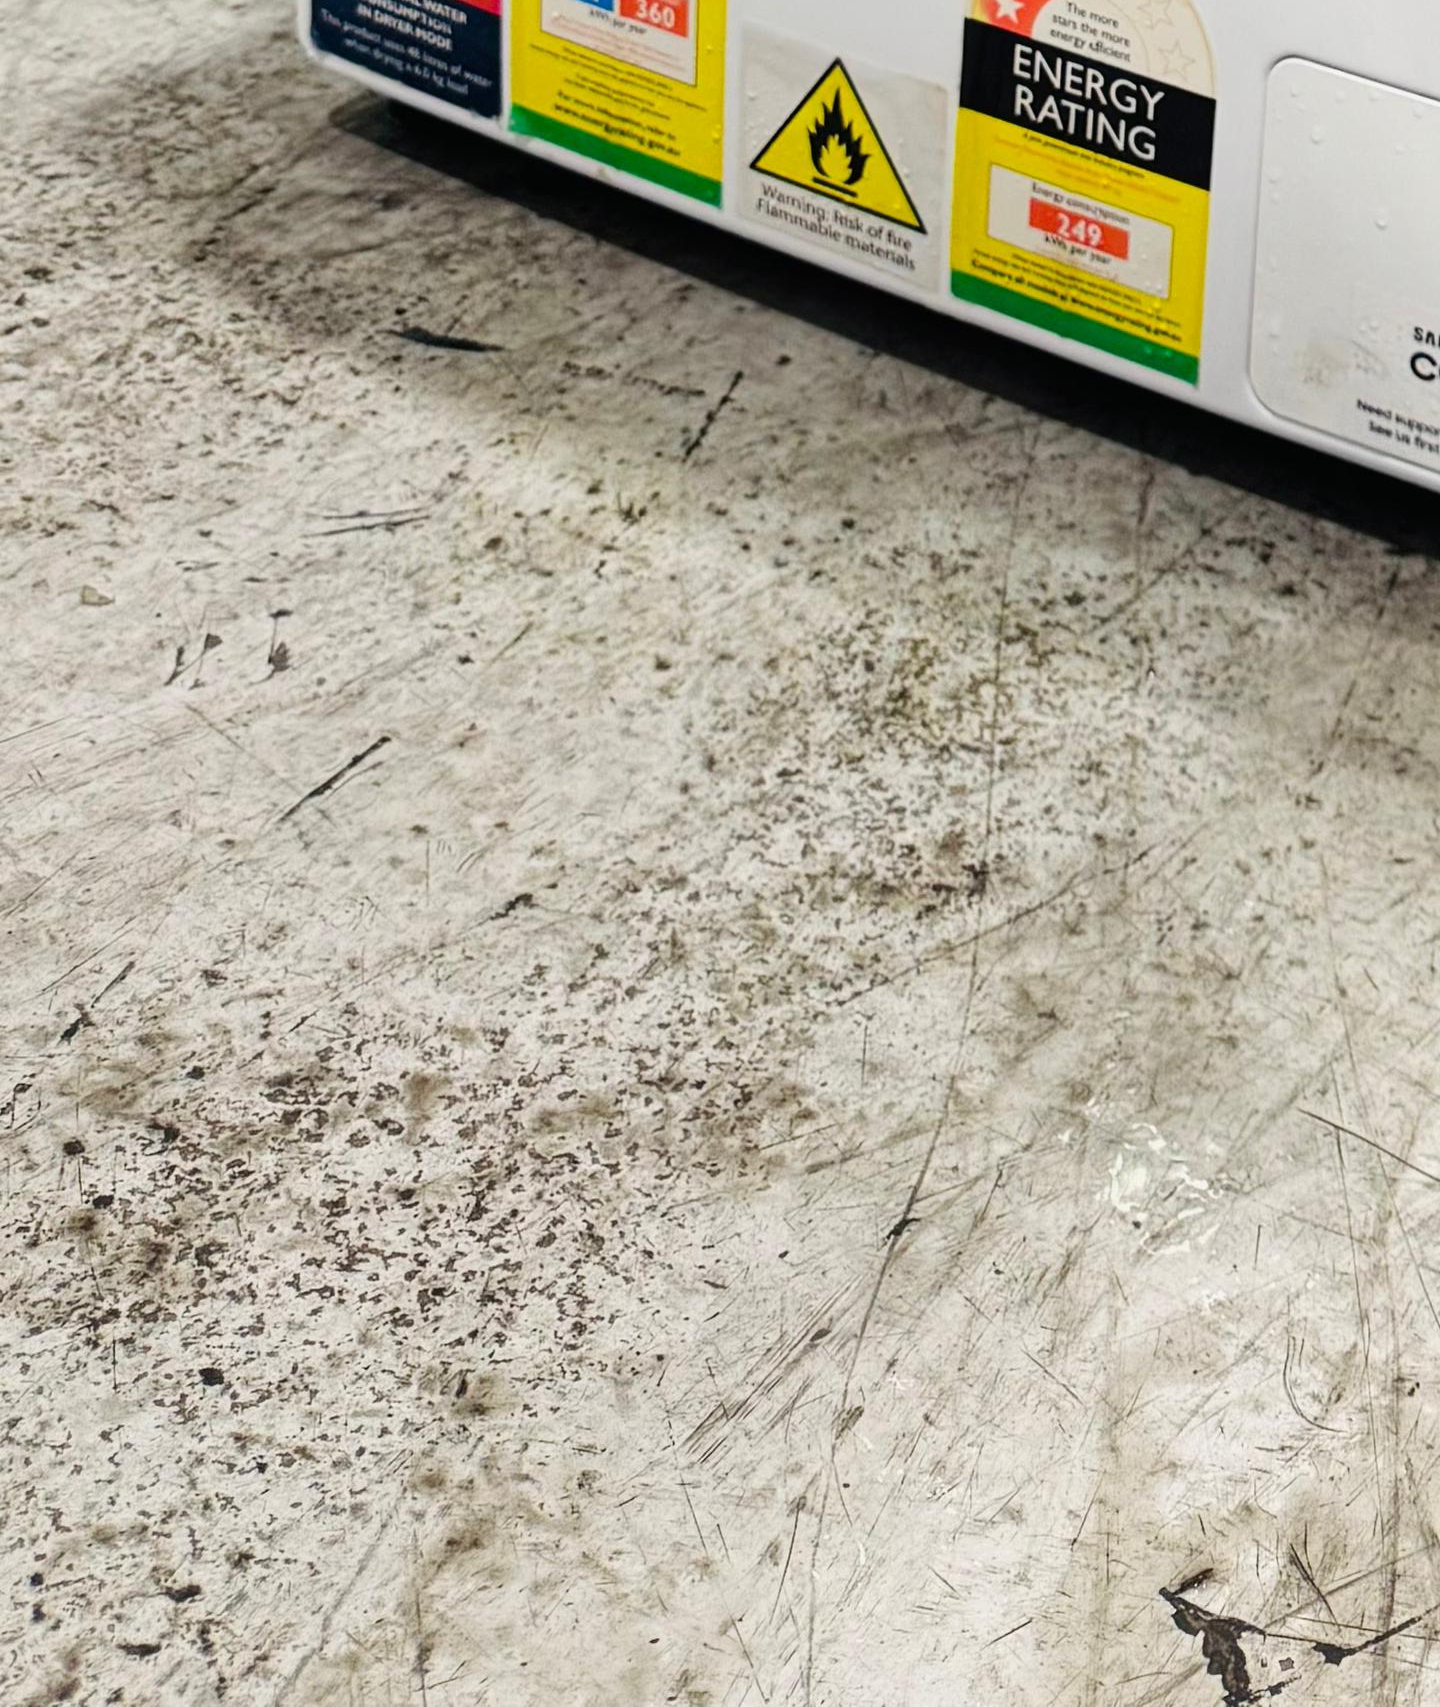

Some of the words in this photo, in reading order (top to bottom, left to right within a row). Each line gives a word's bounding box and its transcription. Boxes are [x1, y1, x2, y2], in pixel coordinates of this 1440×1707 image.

[373, 9, 414, 36] DRYER
[415, 27, 453, 52] MODE
[1051, 13, 1078, 33] stars
[1080, 20, 1099, 37] the
[1101, 30, 1132, 48] more
[1065, 0, 1088, 20] The
[1089, 10, 1120, 29] more
[1049, 28, 1087, 51] energy
[1088, 37, 1132, 63] efficient
[1012, 43, 1166, 122] ENERGY
[1014, 83, 1157, 162] RATING
[1032, 180, 1065, 205] Energy
[756, 197, 843, 243] Flammable
[846, 234, 917, 272] materials
[761, 183, 830, 223] Warning:
[834, 210, 865, 235] Risk
[867, 224, 884, 242] of
[886, 228, 912, 253] fire
[1055, 212, 1104, 247] 249
[1068, 242, 1087, 259] per
[1089, 249, 1113, 266] year
[1356, 398, 1393, 421] Need
[1368, 420, 1394, 439] See
[1394, 430, 1412, 448] us
[1413, 436, 1440, 455] first
